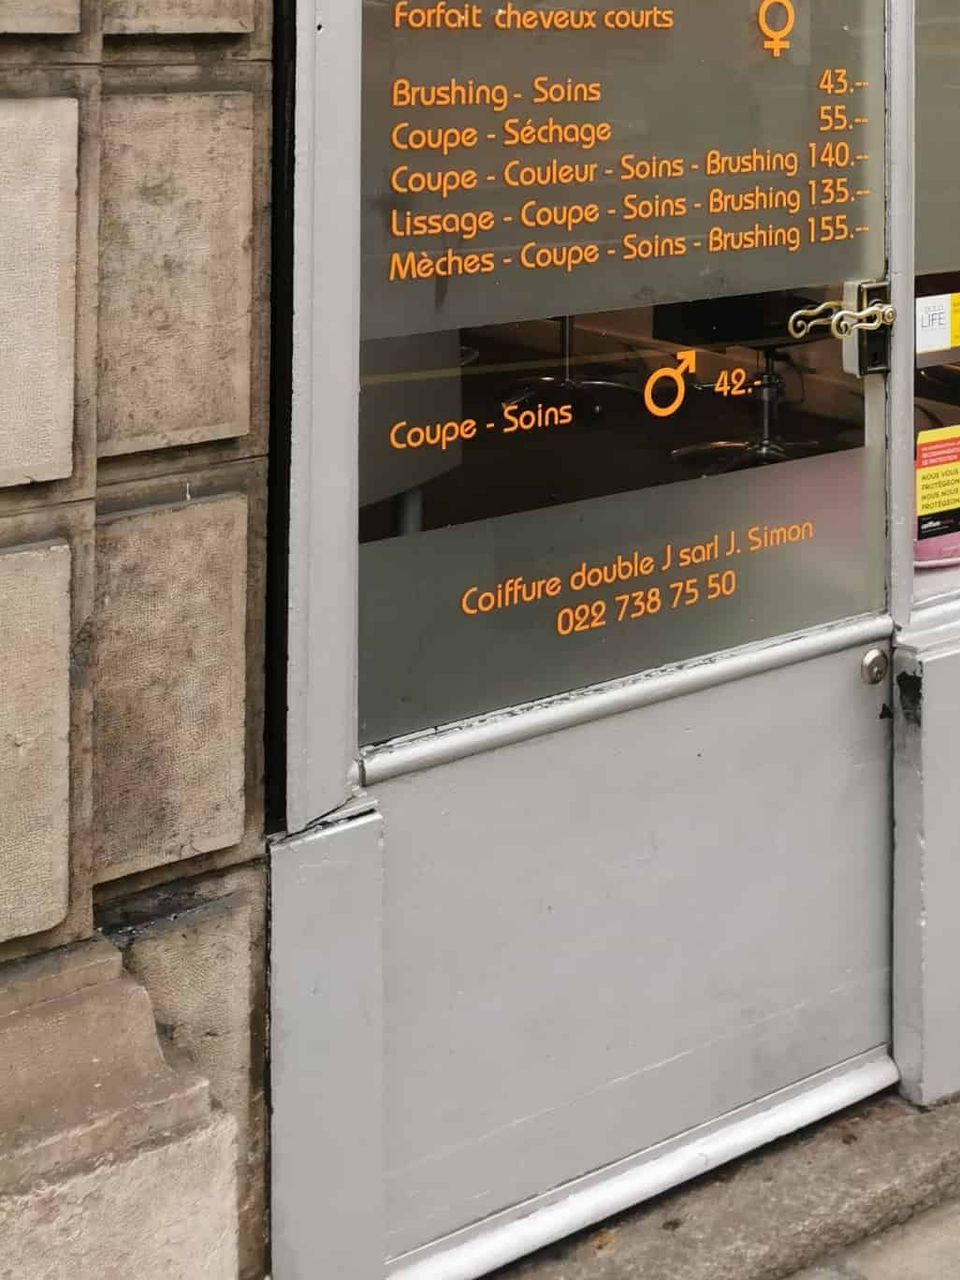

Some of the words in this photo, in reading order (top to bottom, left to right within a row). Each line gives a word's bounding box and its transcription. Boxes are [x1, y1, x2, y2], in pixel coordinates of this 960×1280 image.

[394, 0, 483, 29] Forfait
[494, 2, 597, 30] cheveux
[603, 7, 675, 29] courts
[392, 78, 509, 112] Brushing
[533, 76, 601, 104] Soins
[391, 122, 479, 156] Coupe
[503, 118, 612, 150] Séchage
[391, 165, 478, 198] Coupe
[503, 159, 598, 187] Couleur
[620, 153, 685, 180] Soins
[706, 149, 799, 177] Brushing
[391, 209, 495, 240] Lissage
[520, 200, 600, 232] Coupe
[623, 193, 687, 220] Soins
[709, 186, 801, 214] Brushing
[389, 248, 495, 281] Mèches
[520, 241, 599, 272] Coupe
[622, 233, 687, 260] Soins
[708, 223, 801, 252] Brushing
[921, 312, 946, 329] LIFE
[389, 419, 477, 449] Coupe
[503, 405, 572, 433] Soins
[714, 367, 760, 396] 42.-
[461, 576, 562, 615] Coiffure
[570, 552, 654, 591] double
[662, 546, 672, 571] J
[679, 534, 719, 567] sarl
[727, 531, 739, 555] J.
[747, 521, 814, 552] Simon
[557, 600, 606, 636] 022
[615, 587, 662, 620] 738
[669, 578, 700, 607] 75
[707, 569, 736, 600] 50
